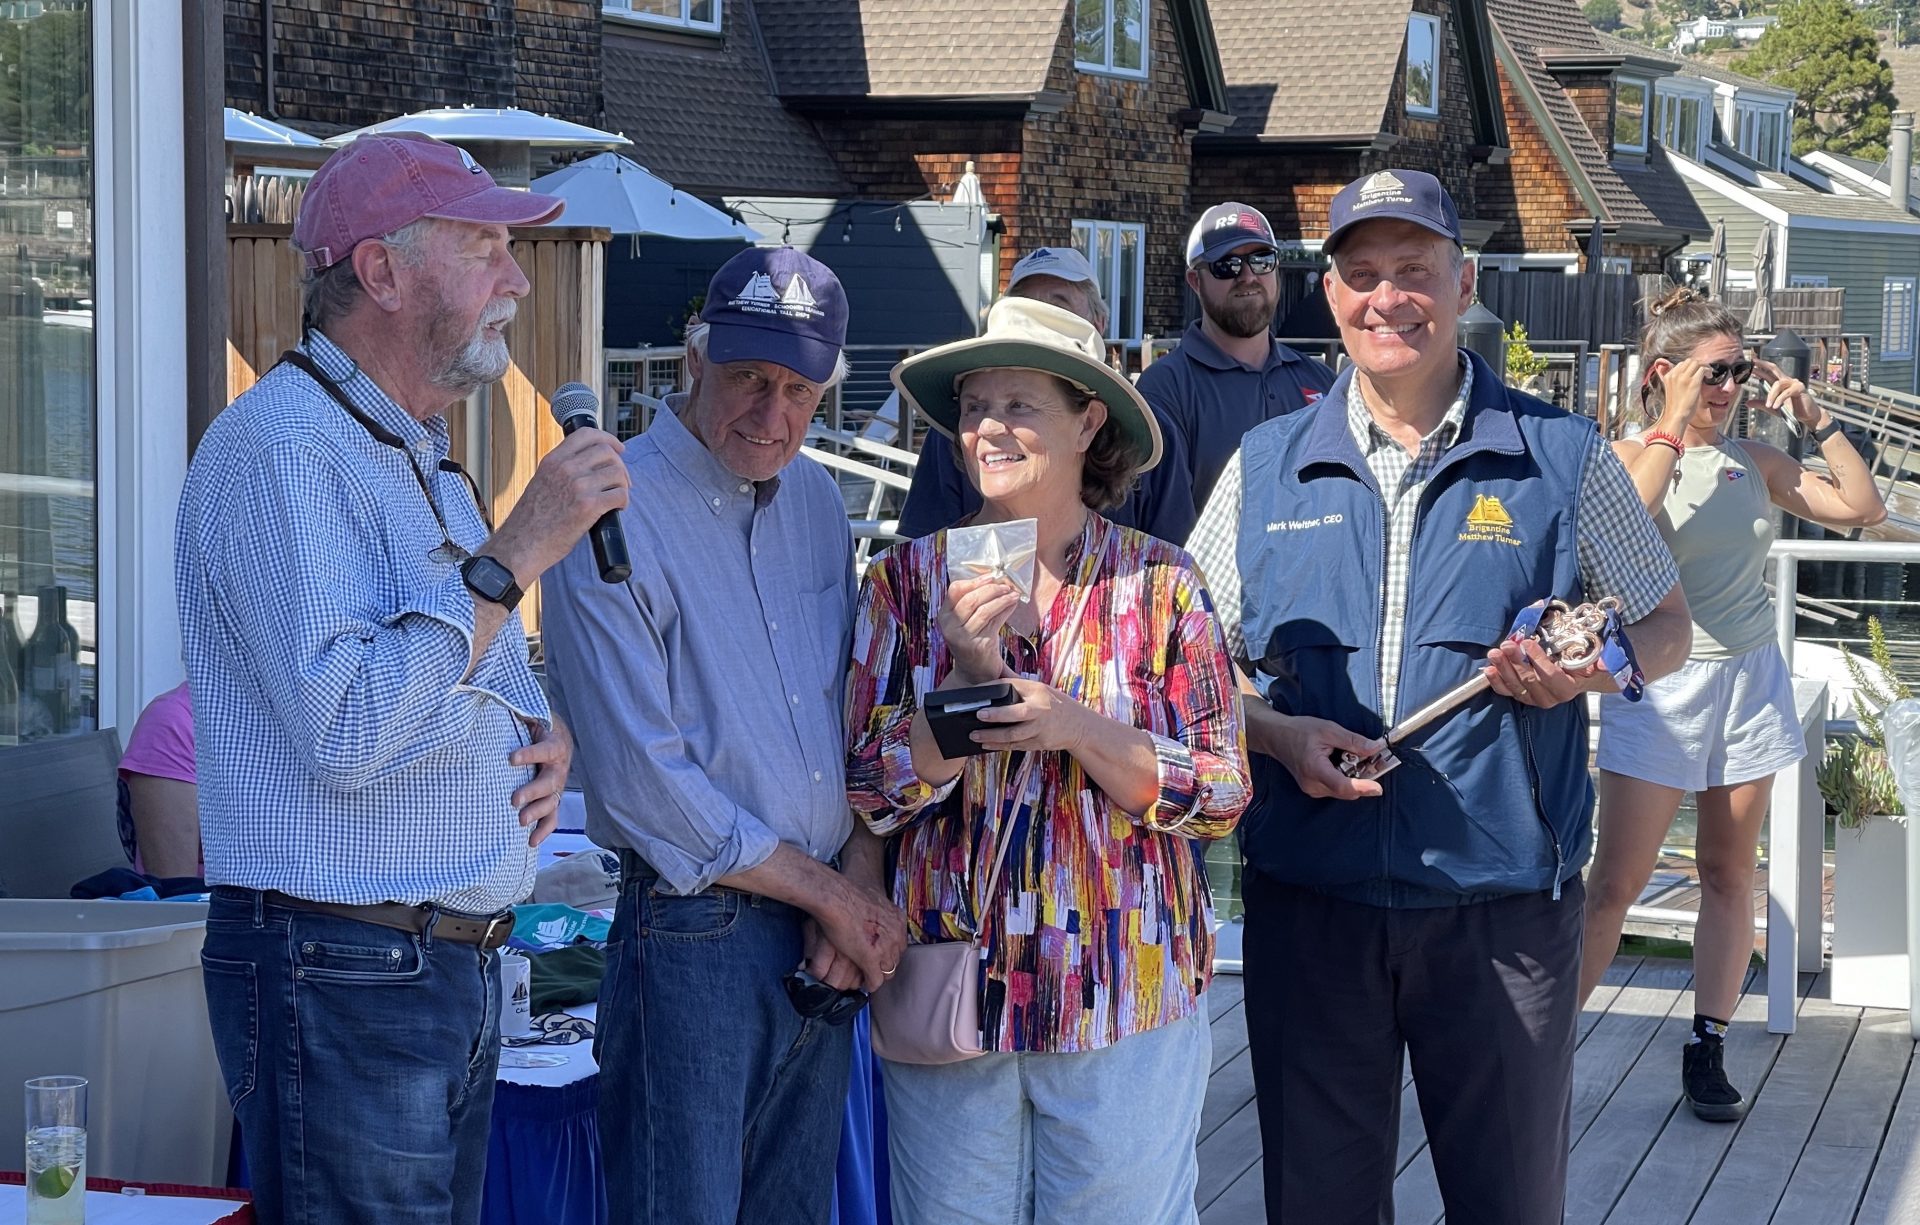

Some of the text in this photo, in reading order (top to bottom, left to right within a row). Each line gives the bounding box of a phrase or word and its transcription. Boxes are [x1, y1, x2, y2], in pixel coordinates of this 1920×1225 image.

[1361, 190, 1402, 201] Brigantine
[1352, 197, 1385, 212] Matthew
[741, 305, 777, 314] EDUCATIONAL
[1266, 521, 1287, 532] Mark
[1323, 513, 1343, 525] CEO
[1468, 524, 1511, 534] Brigantine
[1458, 532, 1522, 546] Matthew Turner
